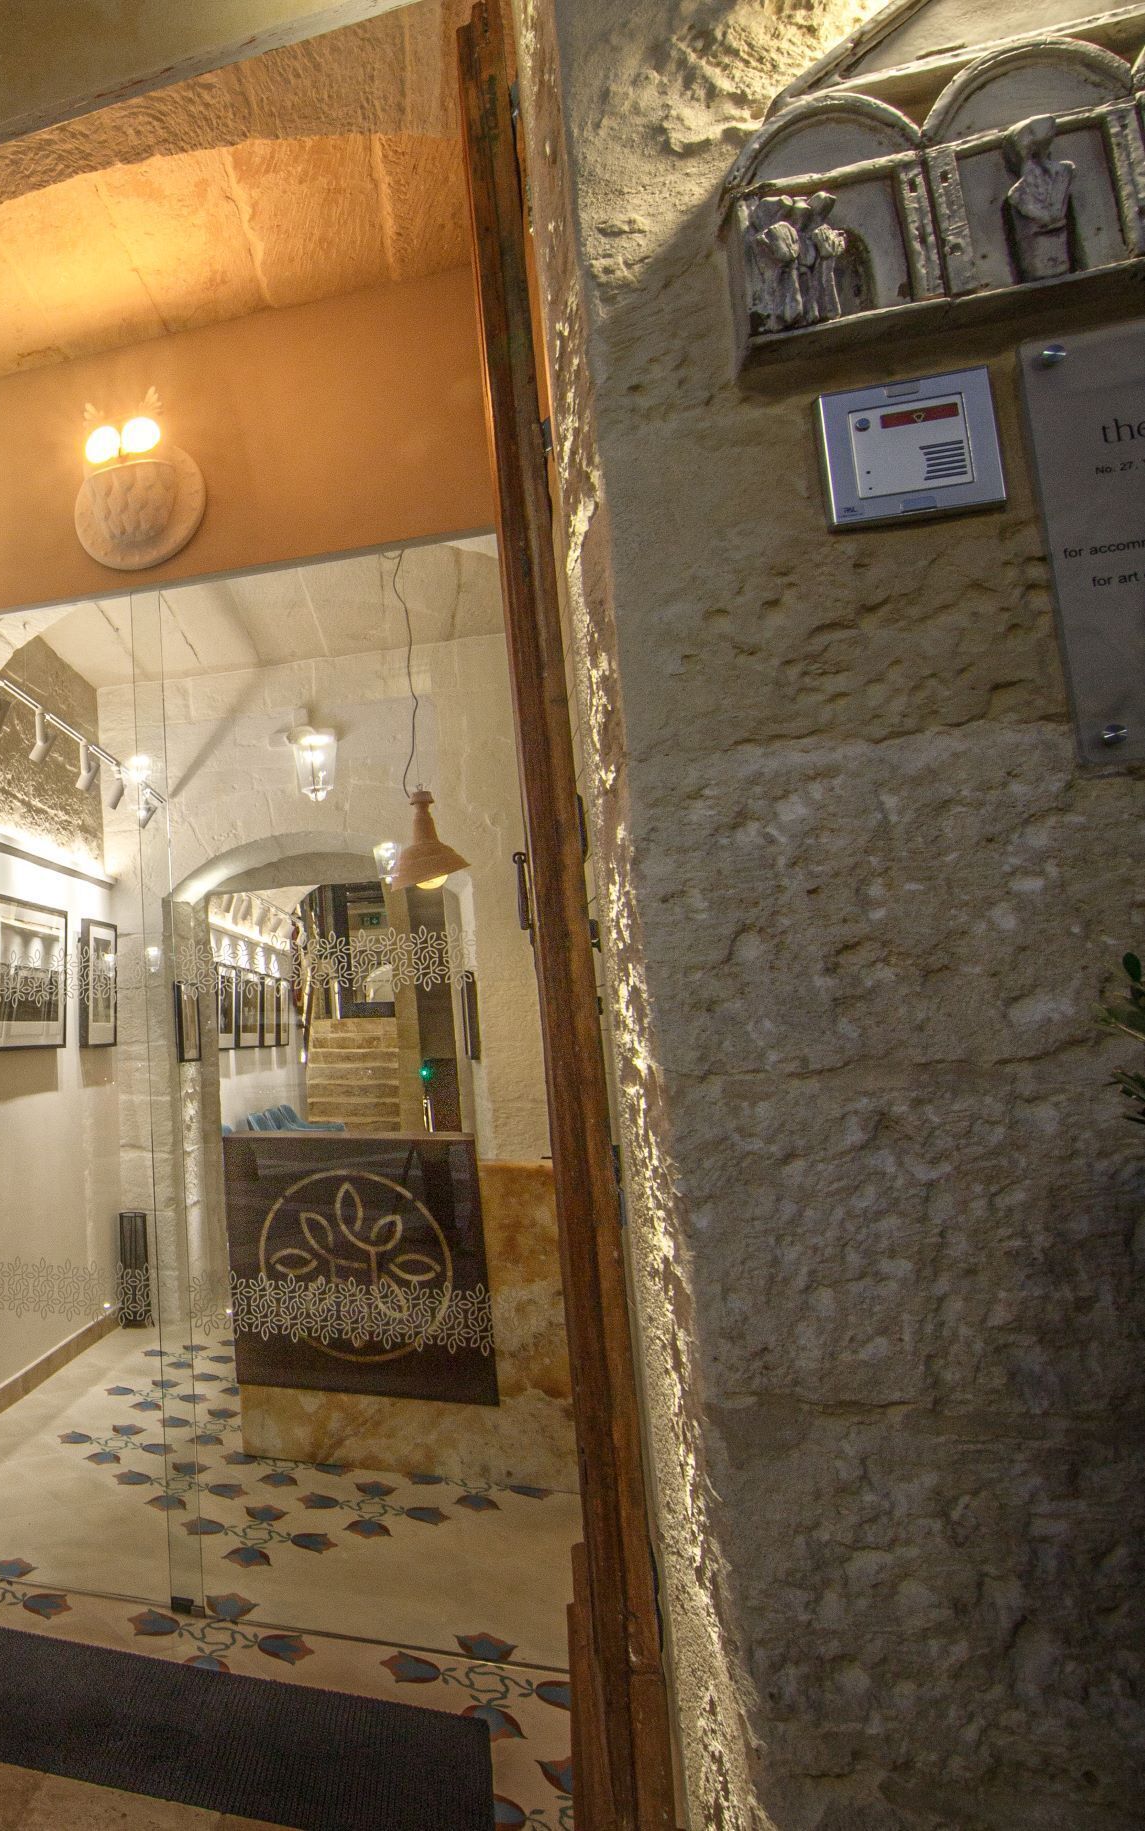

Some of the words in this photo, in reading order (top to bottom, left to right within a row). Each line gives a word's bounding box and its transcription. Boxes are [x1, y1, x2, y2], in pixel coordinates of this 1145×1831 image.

[1063, 547, 1084, 559] for
[1092, 576, 1113, 588] for
[1118, 571, 1140, 584] art
